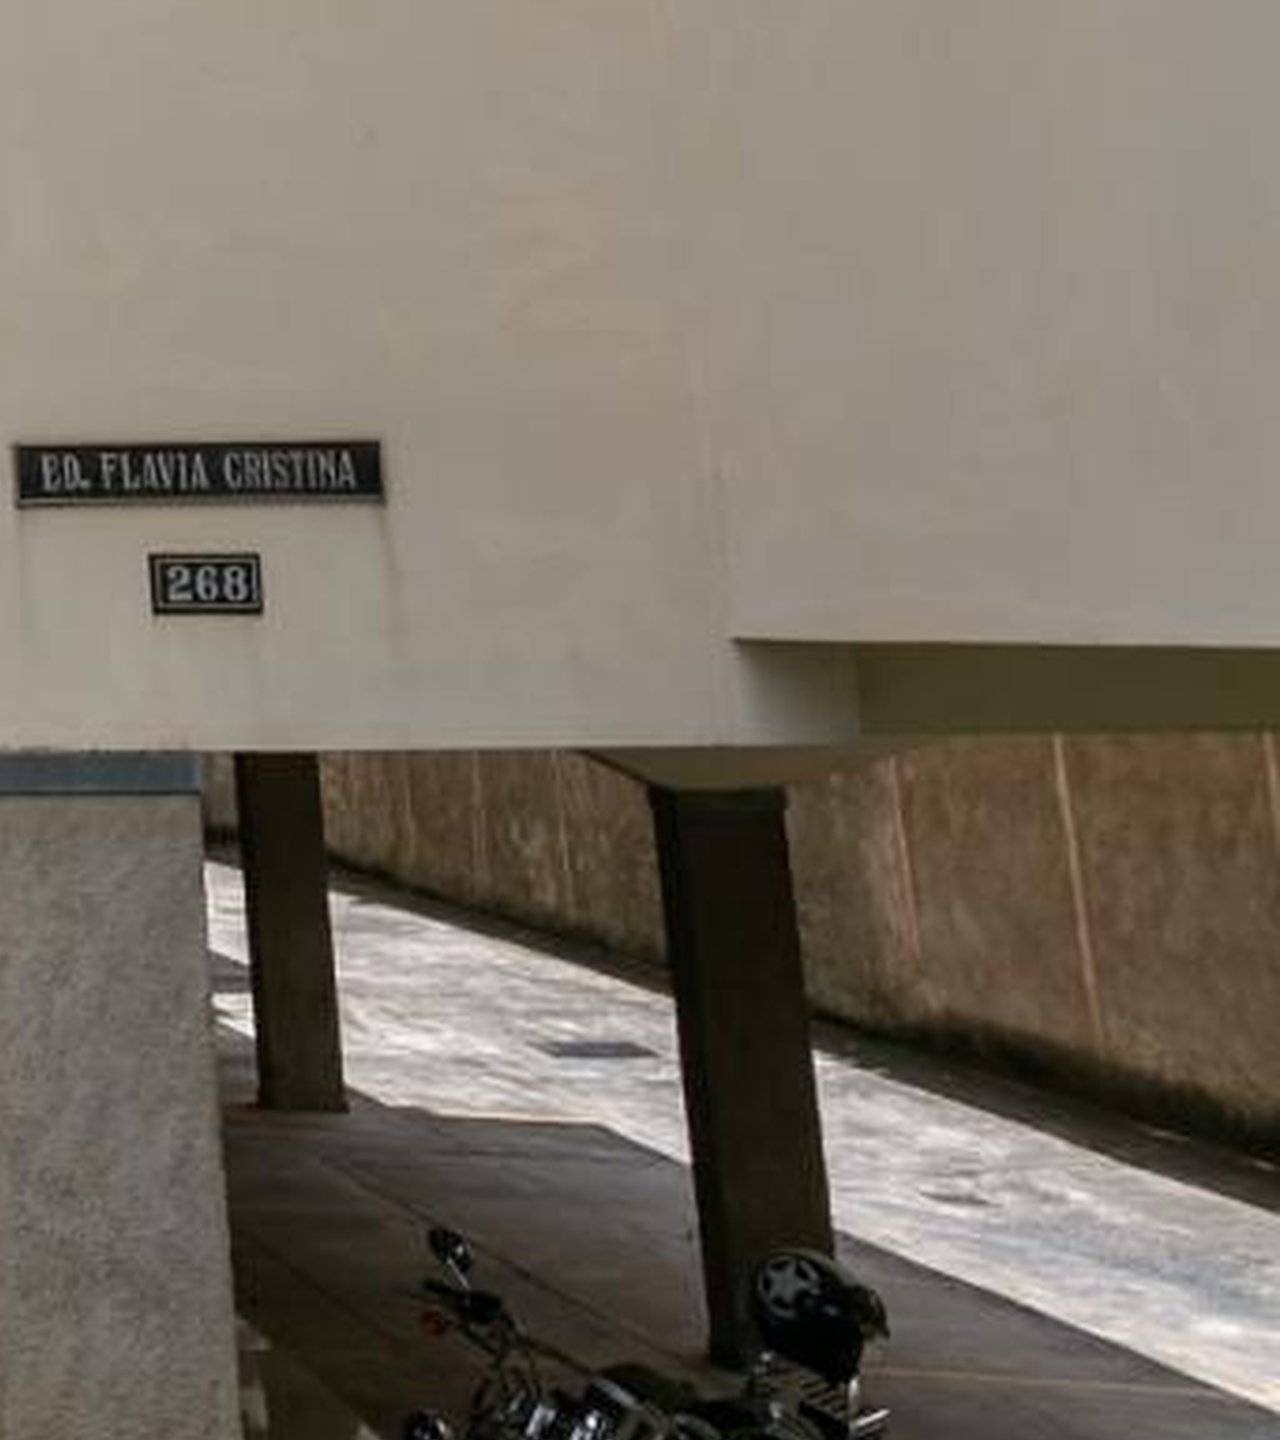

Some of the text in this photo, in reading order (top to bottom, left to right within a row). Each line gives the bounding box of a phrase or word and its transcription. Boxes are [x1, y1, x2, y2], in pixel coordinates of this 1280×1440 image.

[40, 450, 357, 490] ED. FLAVIA CRISTINA
[166, 565, 249, 602] 268
